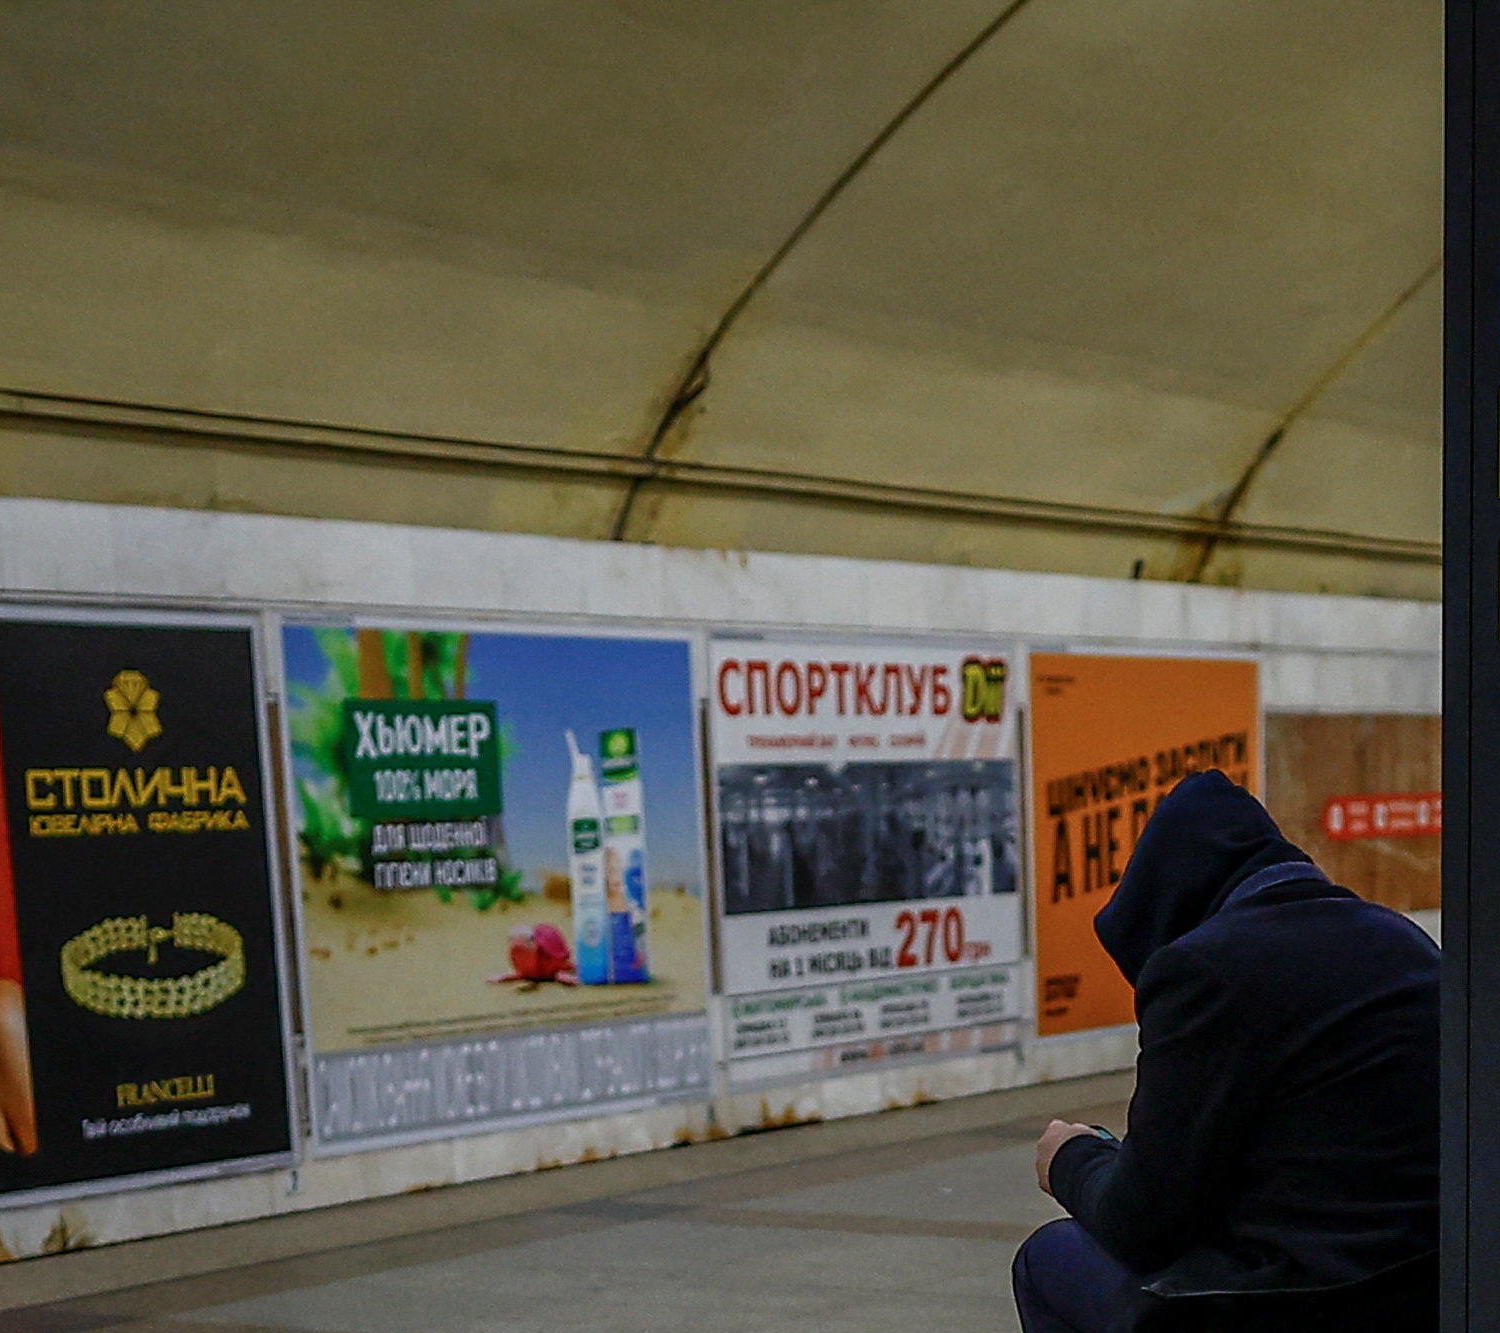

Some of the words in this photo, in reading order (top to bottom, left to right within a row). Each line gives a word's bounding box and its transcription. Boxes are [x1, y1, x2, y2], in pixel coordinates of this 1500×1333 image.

[718, 658, 952, 716] СПОРТКЛУБ
[353, 711, 492, 760] ХЬЮМЕР
[24, 765, 248, 811] СТОЛИЧНА
[422, 767, 478, 801] МОРЯ
[894, 906, 966, 967] 270
